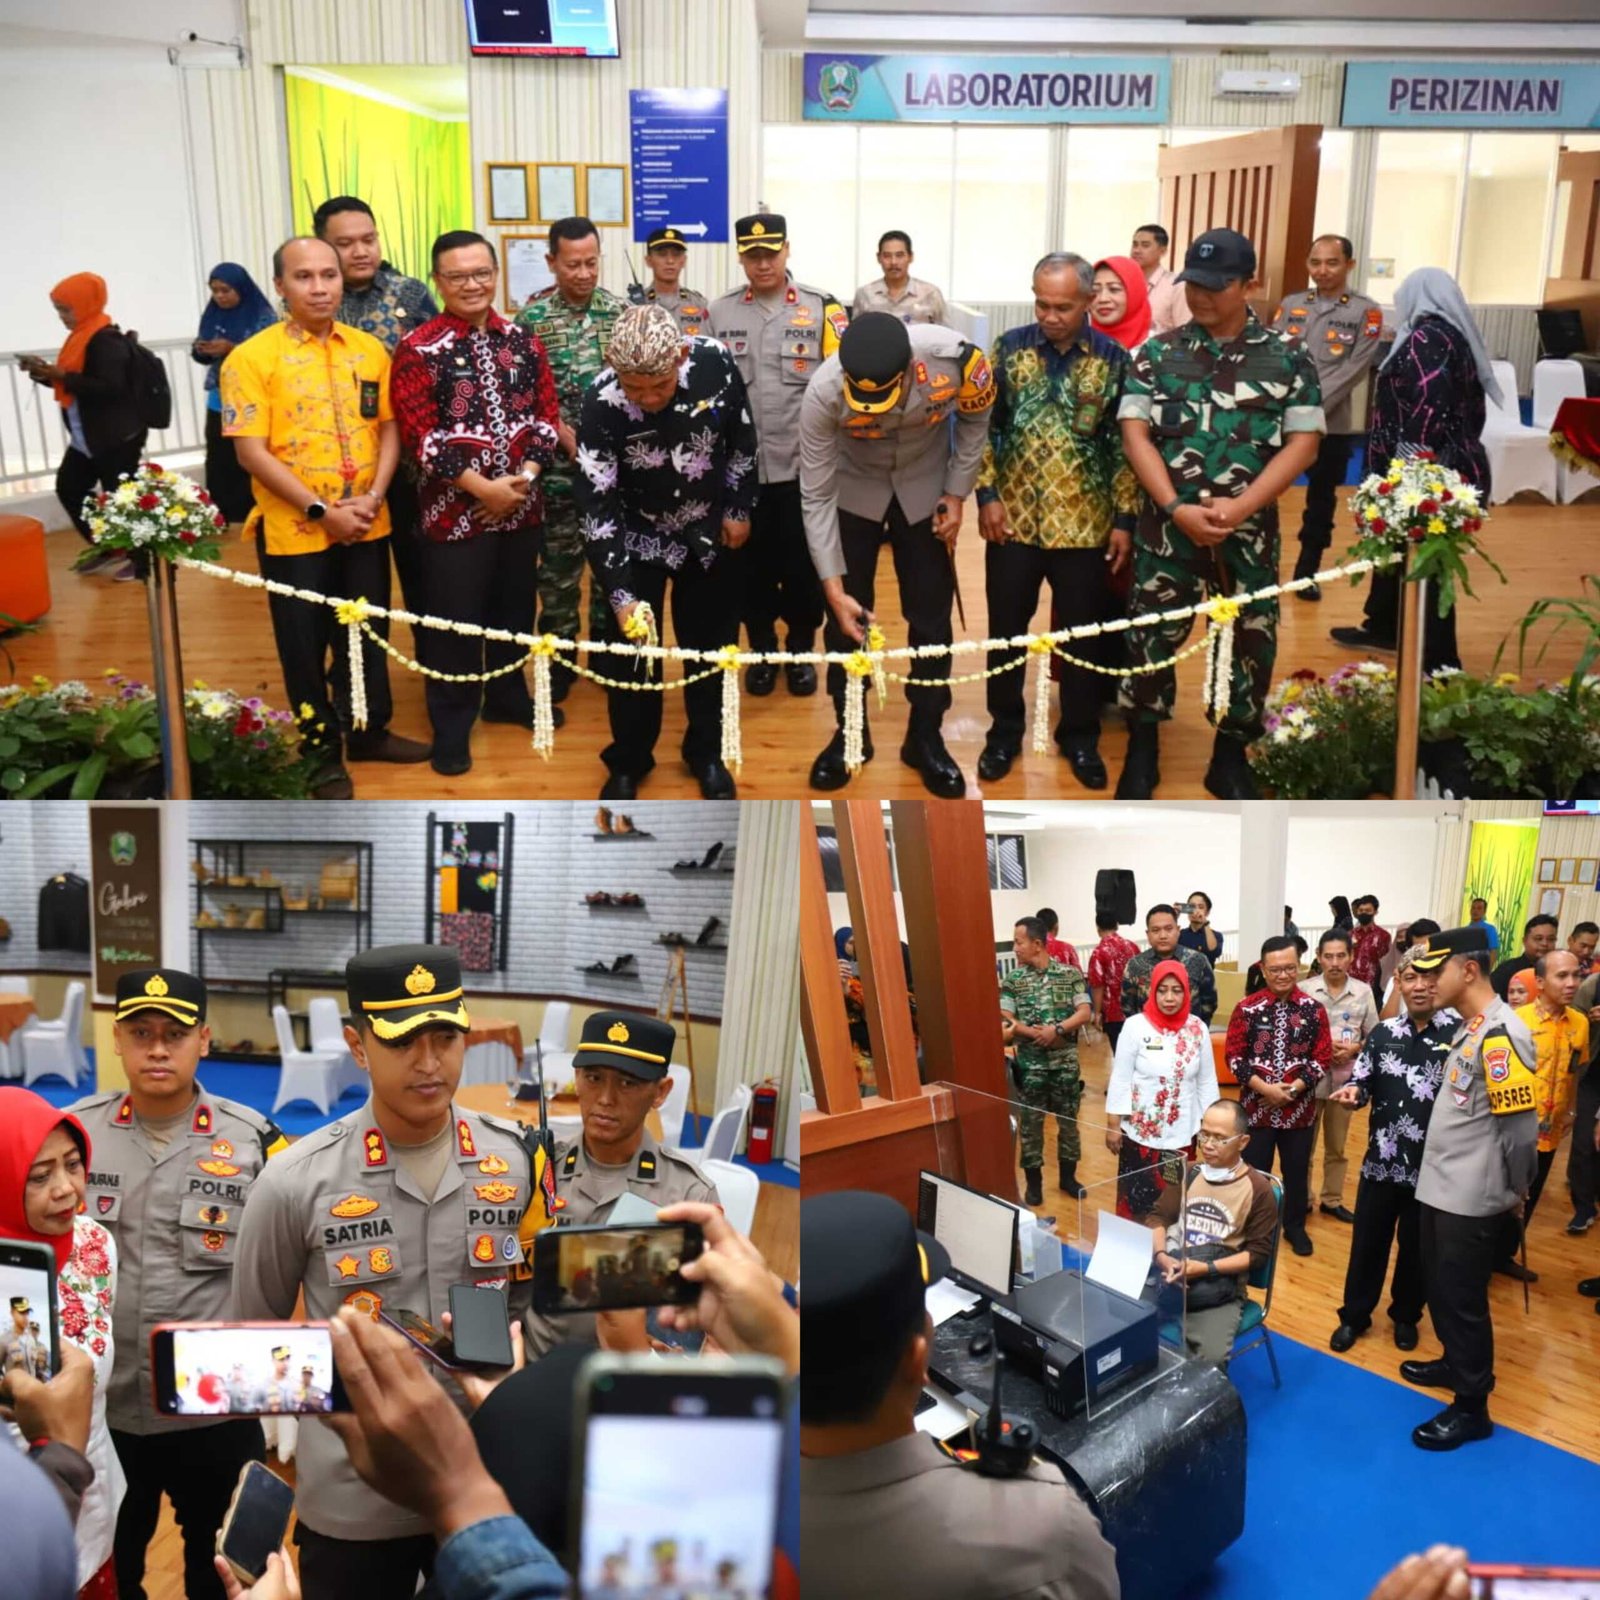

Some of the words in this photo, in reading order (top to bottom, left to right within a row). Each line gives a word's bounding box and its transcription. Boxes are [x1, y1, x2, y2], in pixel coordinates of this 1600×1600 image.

[904, 72, 1154, 109] LABORATORIUM
[1388, 77, 1561, 113] PERIZINAN
[785, 328, 817, 339] POLRI
[1328, 319, 1357, 330] POLRI
[189, 1179, 243, 1200] POLRI
[469, 1208, 522, 1226] POLRI
[324, 1218, 394, 1245] SATRIA
